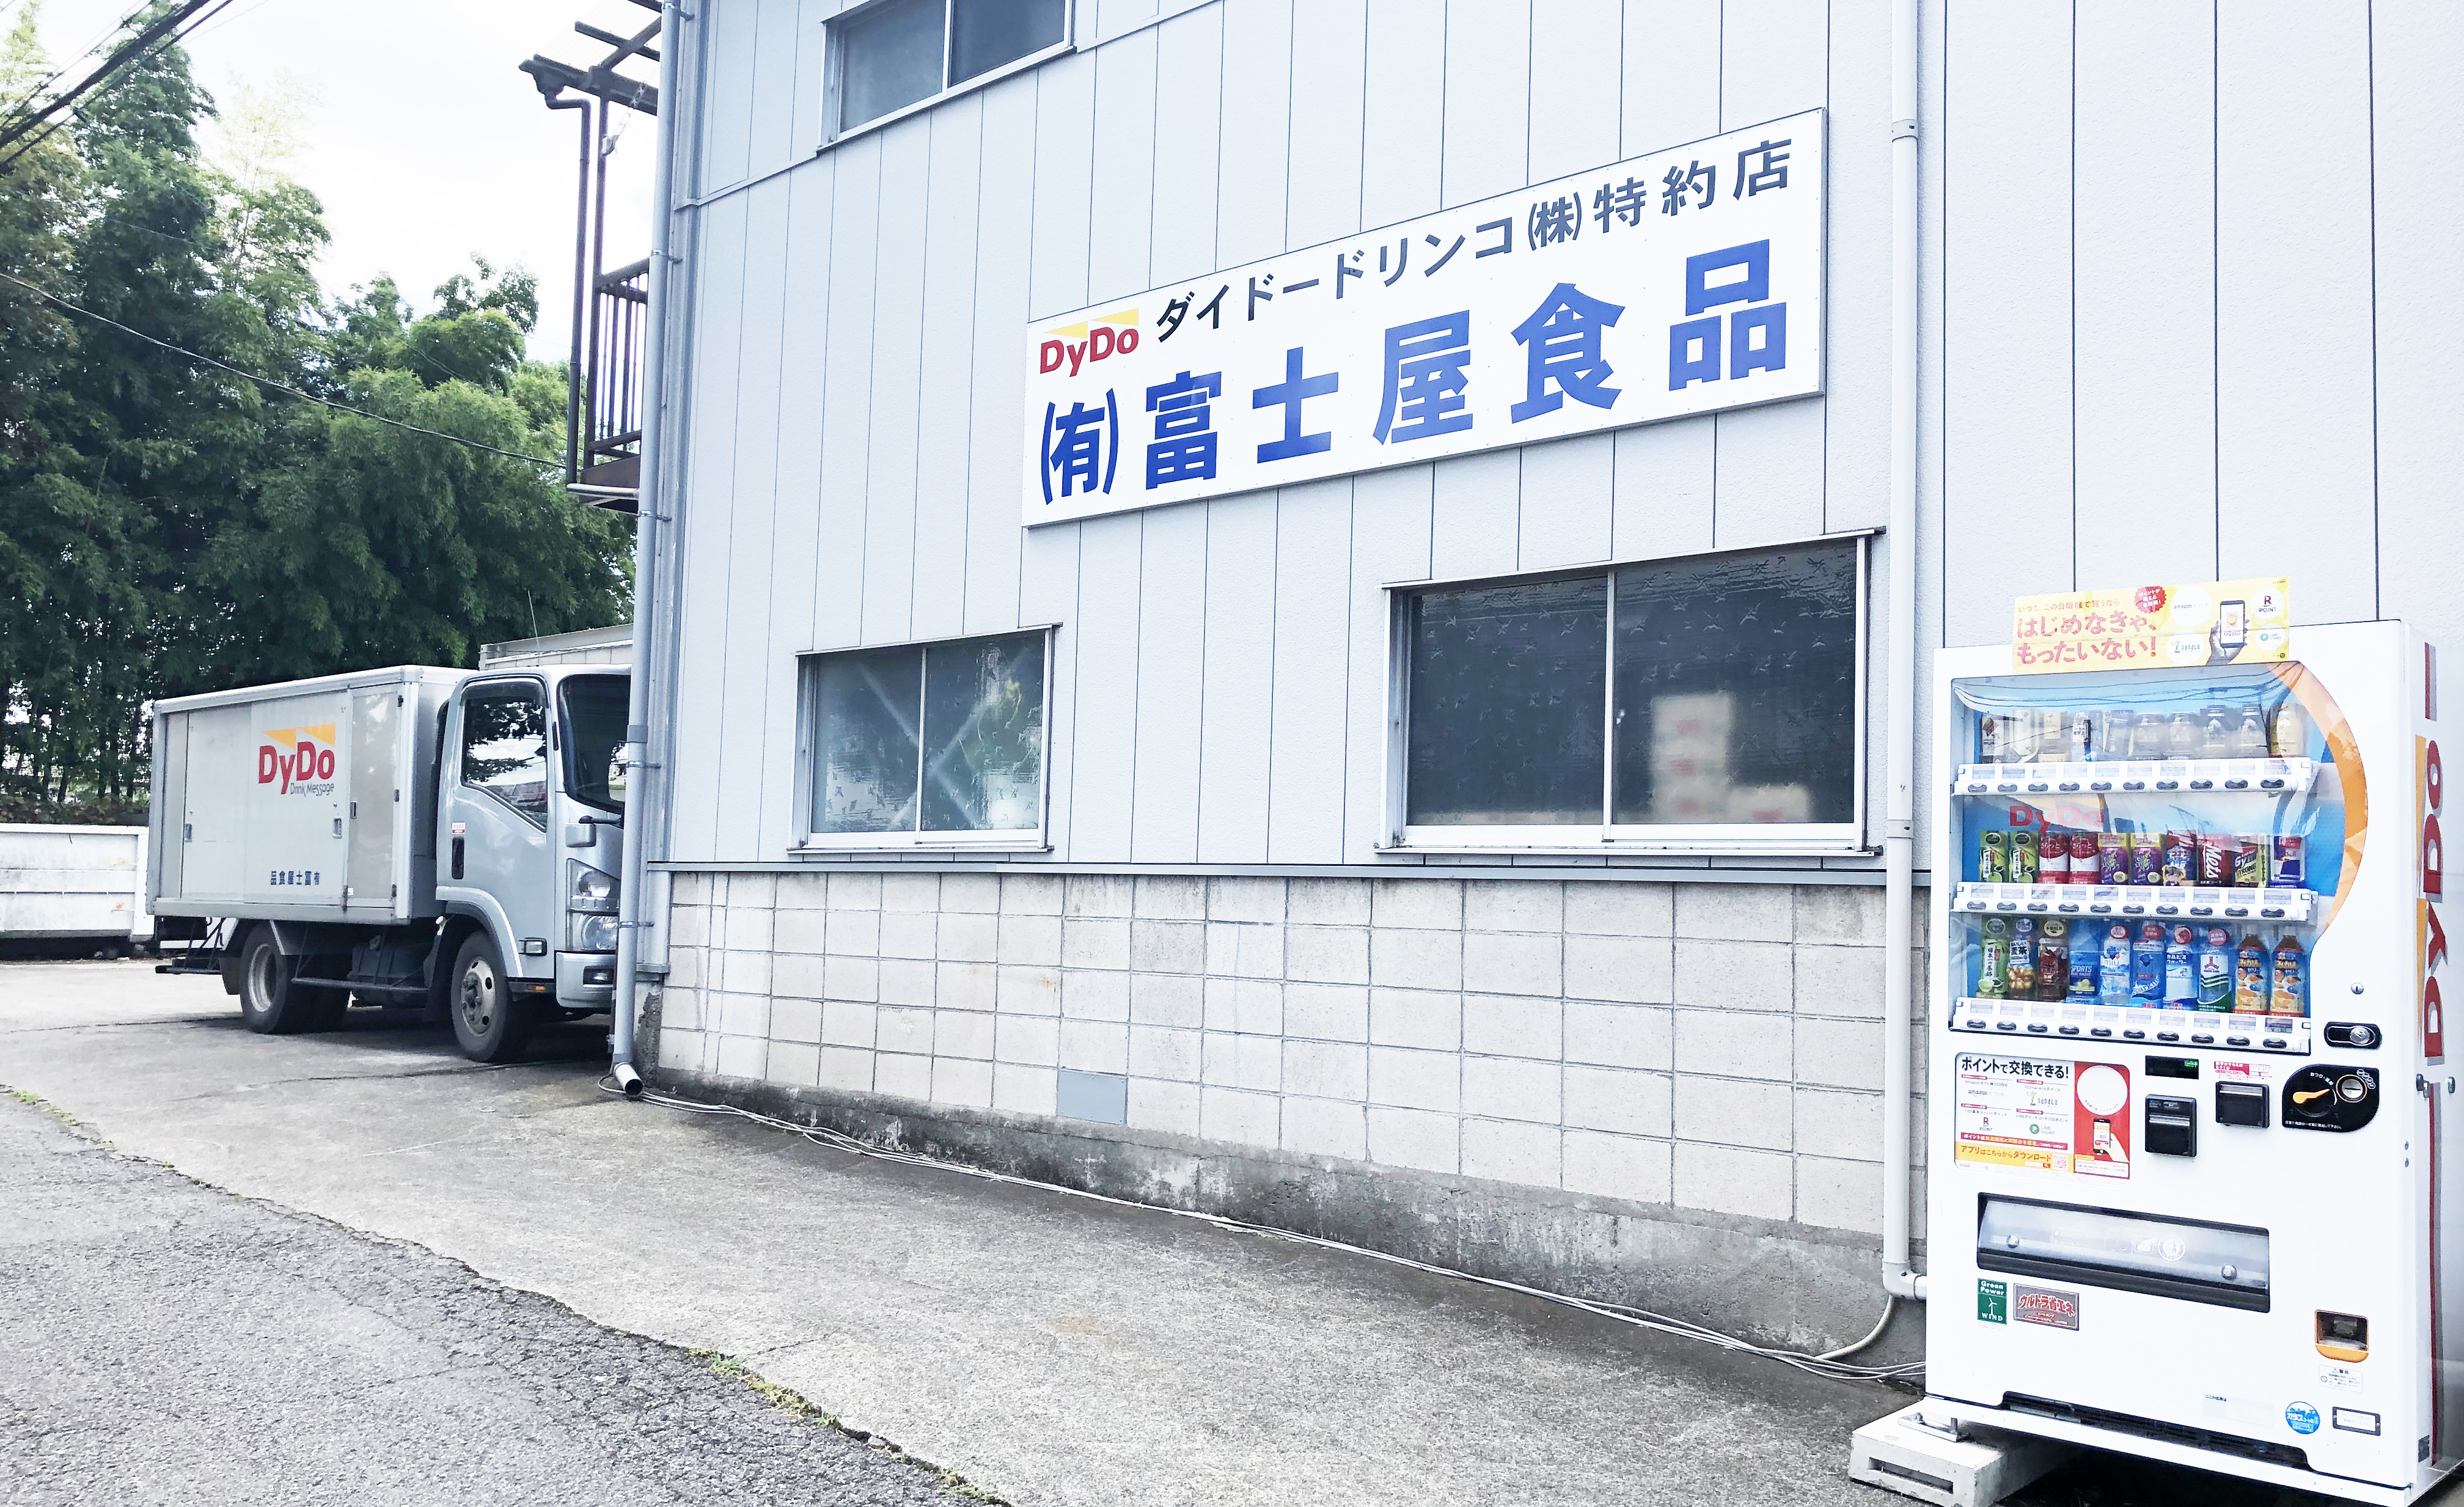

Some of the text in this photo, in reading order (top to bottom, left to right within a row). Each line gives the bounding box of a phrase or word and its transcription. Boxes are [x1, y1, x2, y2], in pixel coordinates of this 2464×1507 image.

[1040, 324, 1139, 378] DyDo
[2017, 610, 2157, 639] はじめなきゃ、
[258, 741, 335, 795] DyDo
[306, 782, 334, 796] Message
[2010, 805, 2105, 834] DyDo
[2205, 843, 2223, 879] Mets
[1962, 1056, 2069, 1079] ポイントで交換できる!
[1960, 1145, 2053, 1162] アプリはこちらからダウンロード
[1980, 1286, 2004, 1296] Power
[1981, 1280, 2004, 1290] Green
[1981, 1312, 2003, 1322] WIND
[2017, 1293, 2075, 1318] ウルトラ省エネ
